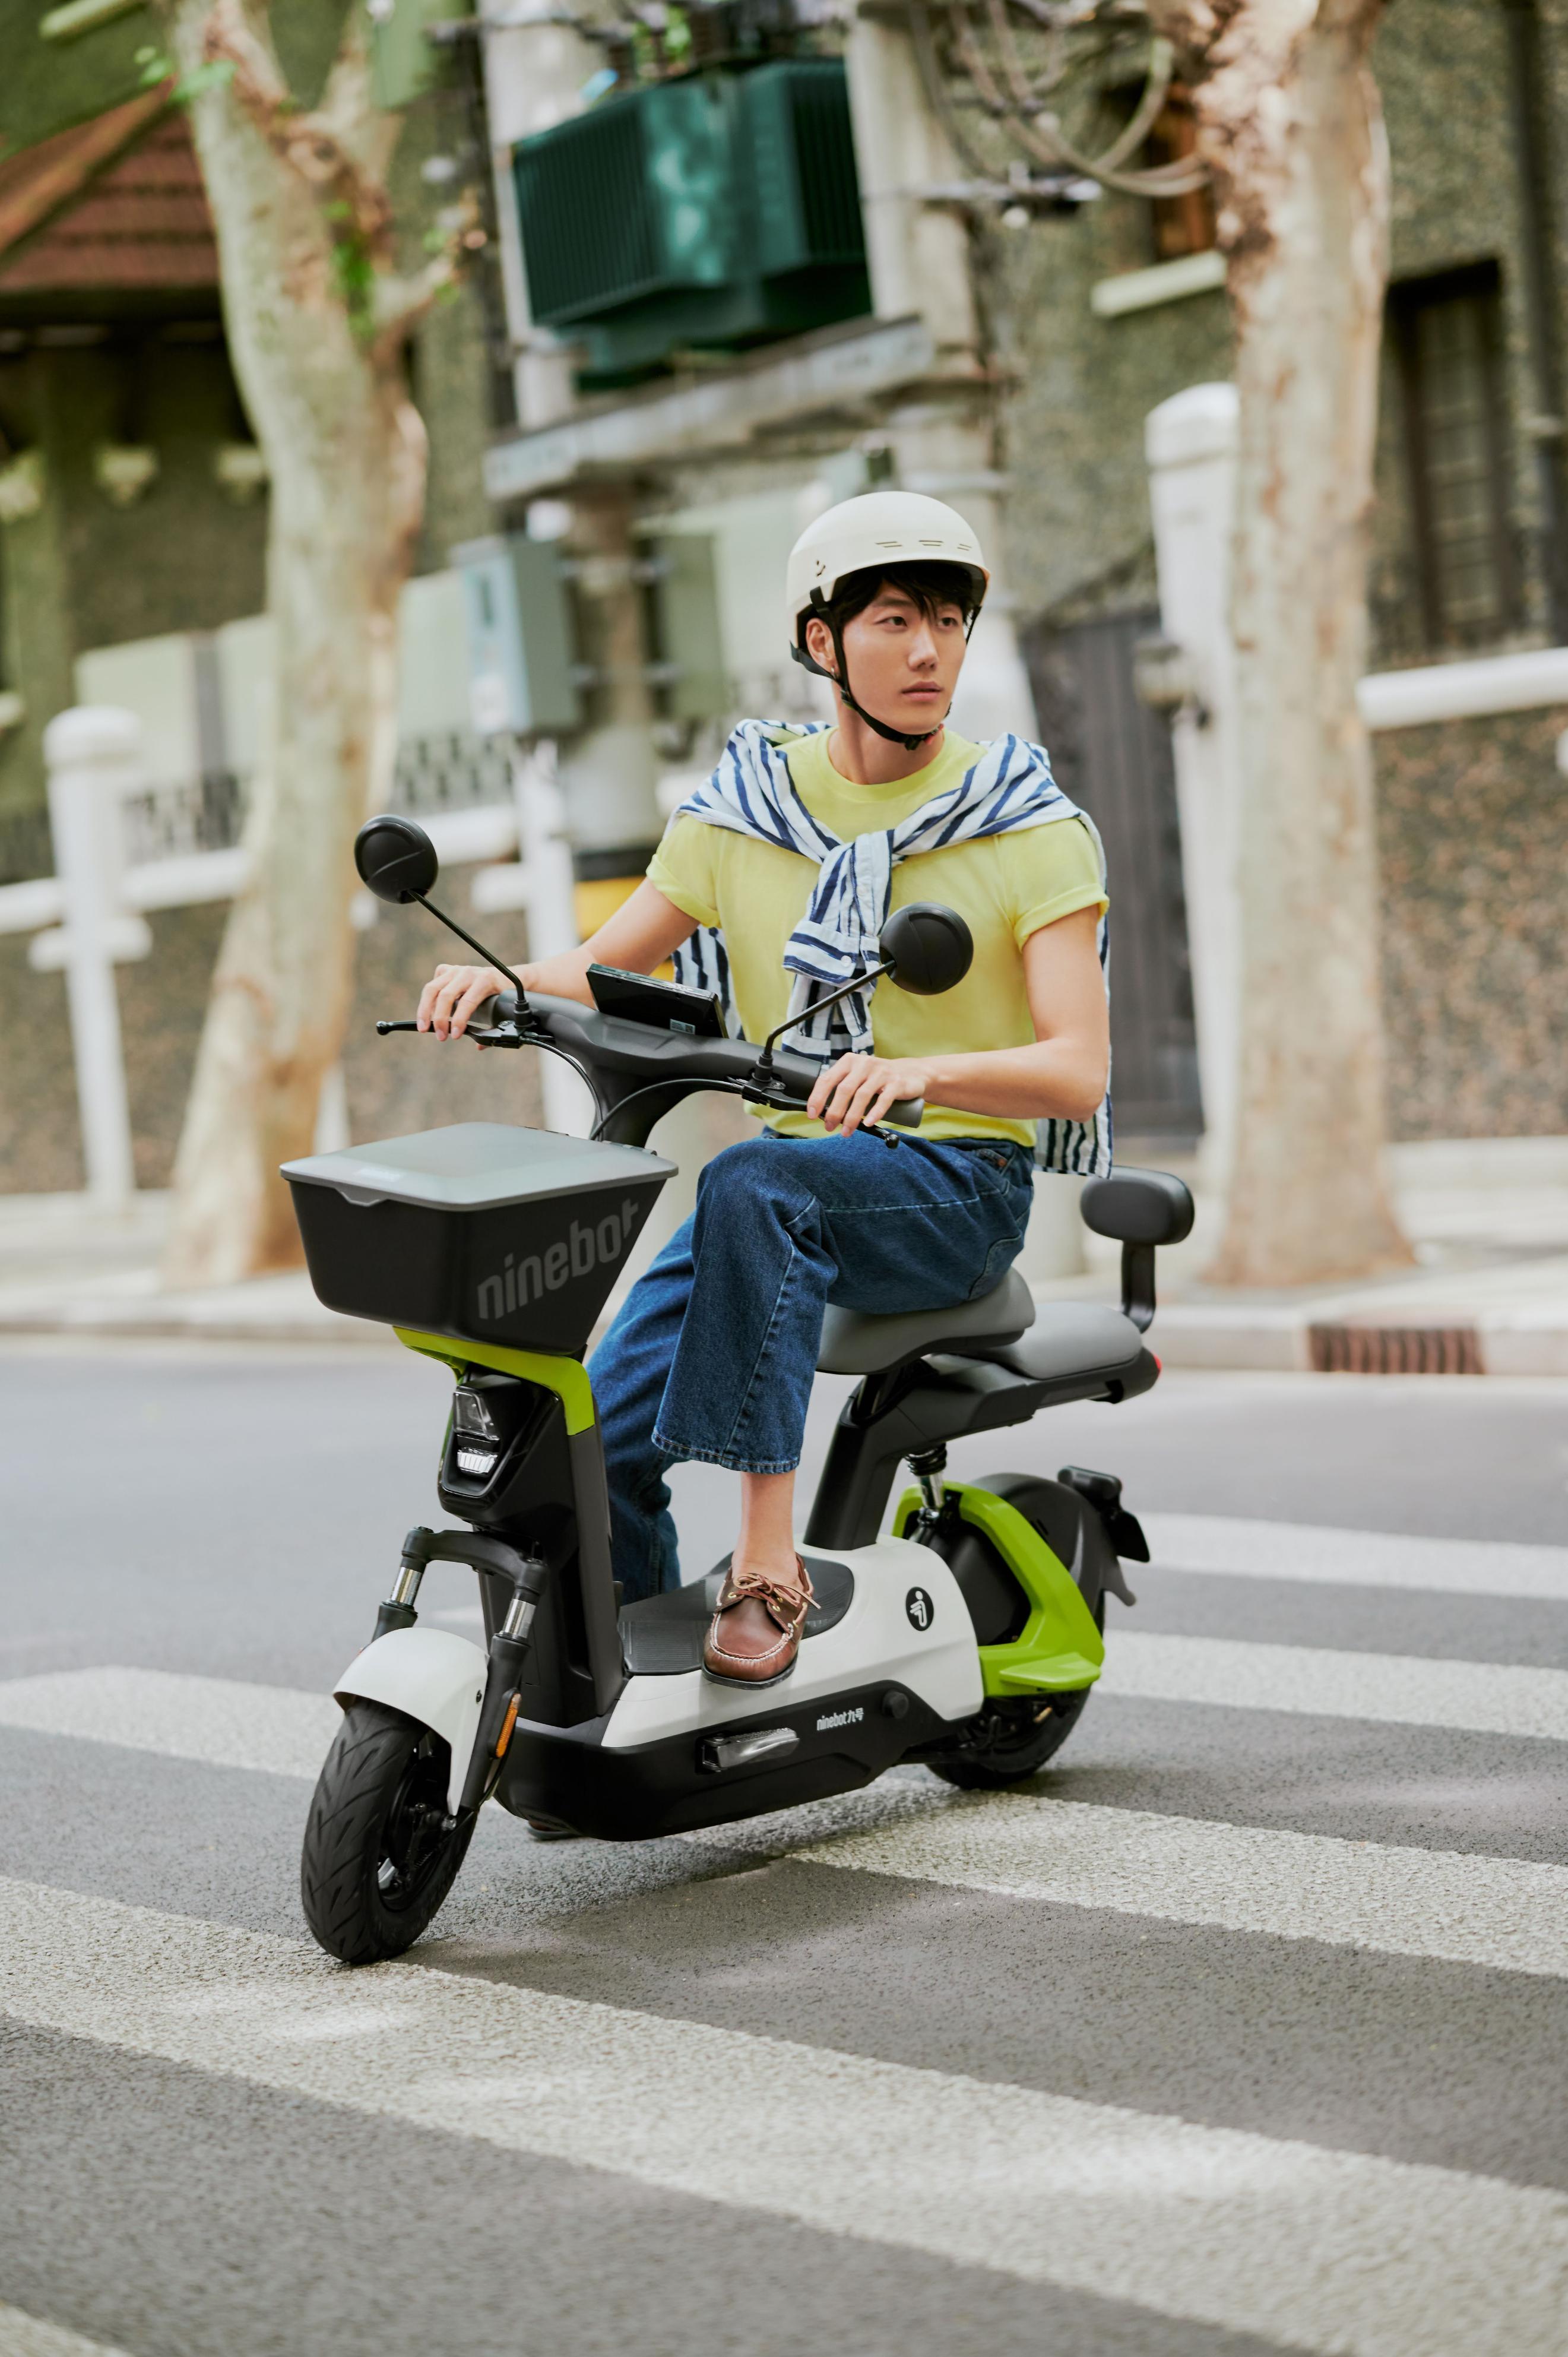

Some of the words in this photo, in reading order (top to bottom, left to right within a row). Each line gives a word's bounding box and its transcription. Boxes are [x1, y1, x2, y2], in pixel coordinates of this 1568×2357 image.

[477, 1198, 639, 1320] ninebot
[817, 1711, 847, 1730] ninebot
[847, 1707, 864, 1723] 九号
